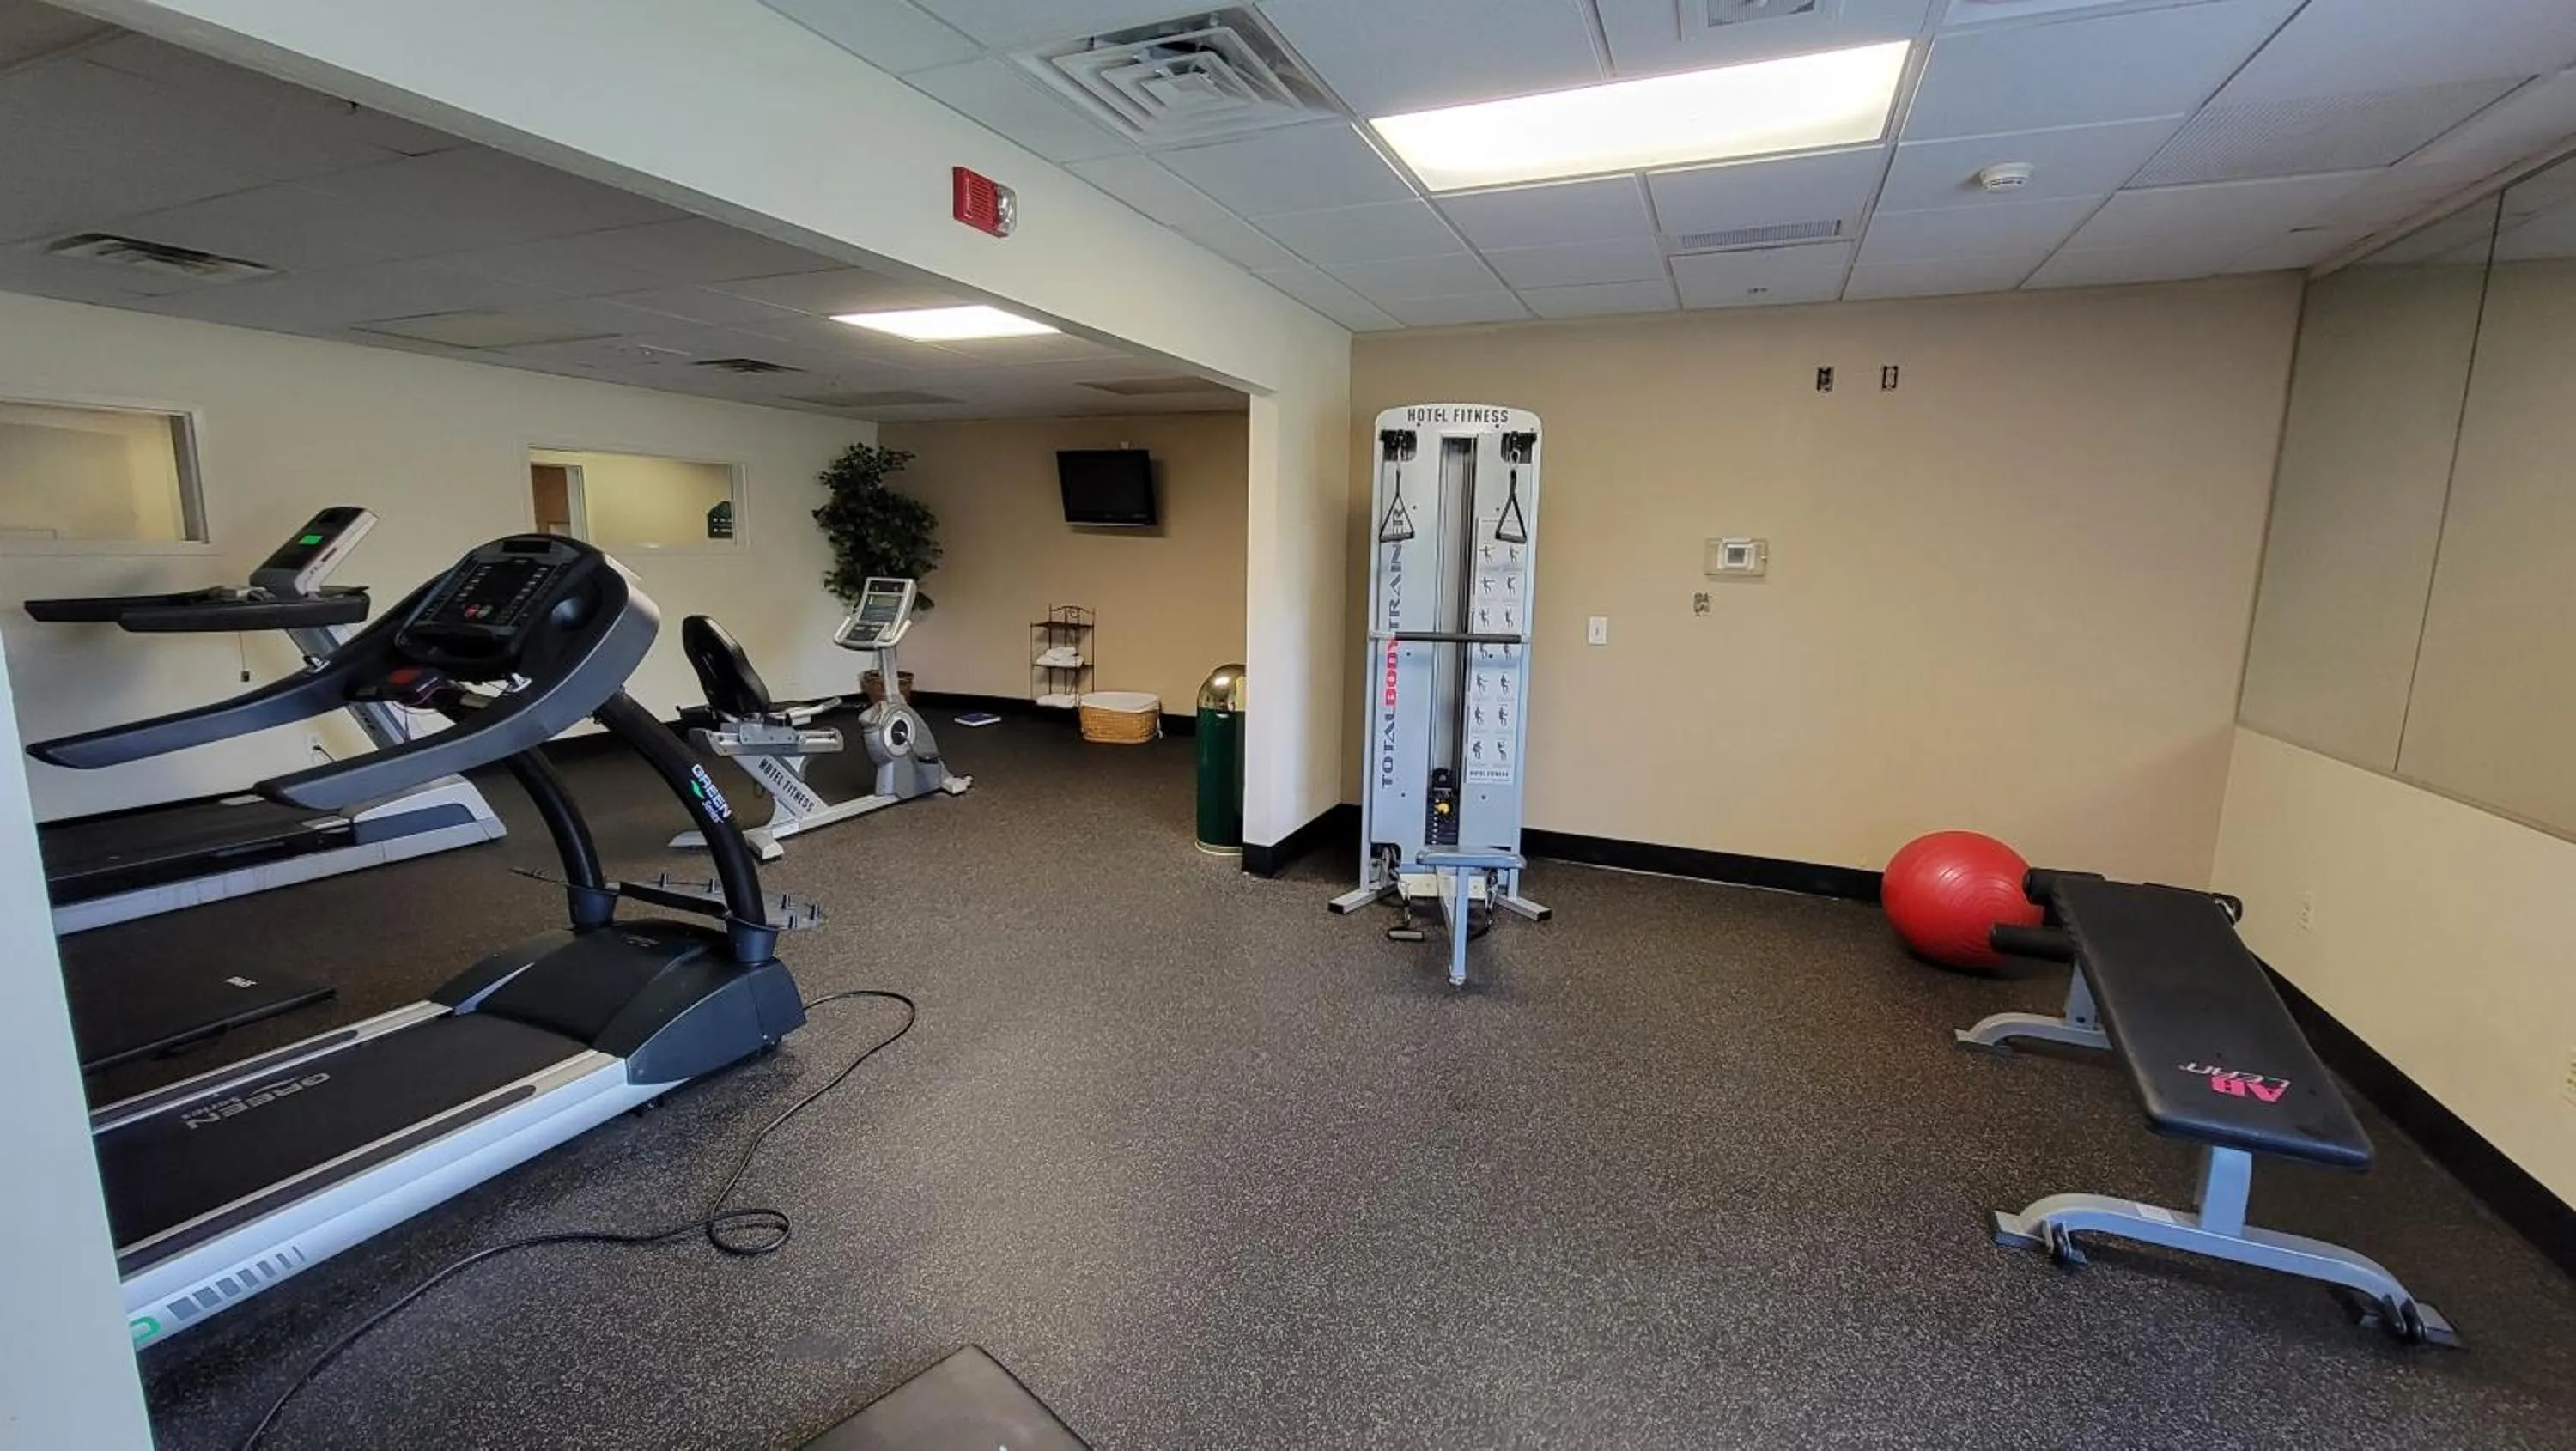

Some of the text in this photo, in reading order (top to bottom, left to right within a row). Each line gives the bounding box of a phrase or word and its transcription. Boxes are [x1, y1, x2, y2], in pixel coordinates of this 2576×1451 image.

[1407, 408, 1509, 423] HOTEL FITNESS
[1382, 708, 1396, 789] TOTAL
[691, 763, 732, 818] GREEN
[758, 758, 815, 812] HOTEL FITNESS
[185, 1072, 331, 1129] GREEN
[2210, 1072, 2286, 1102] AB
